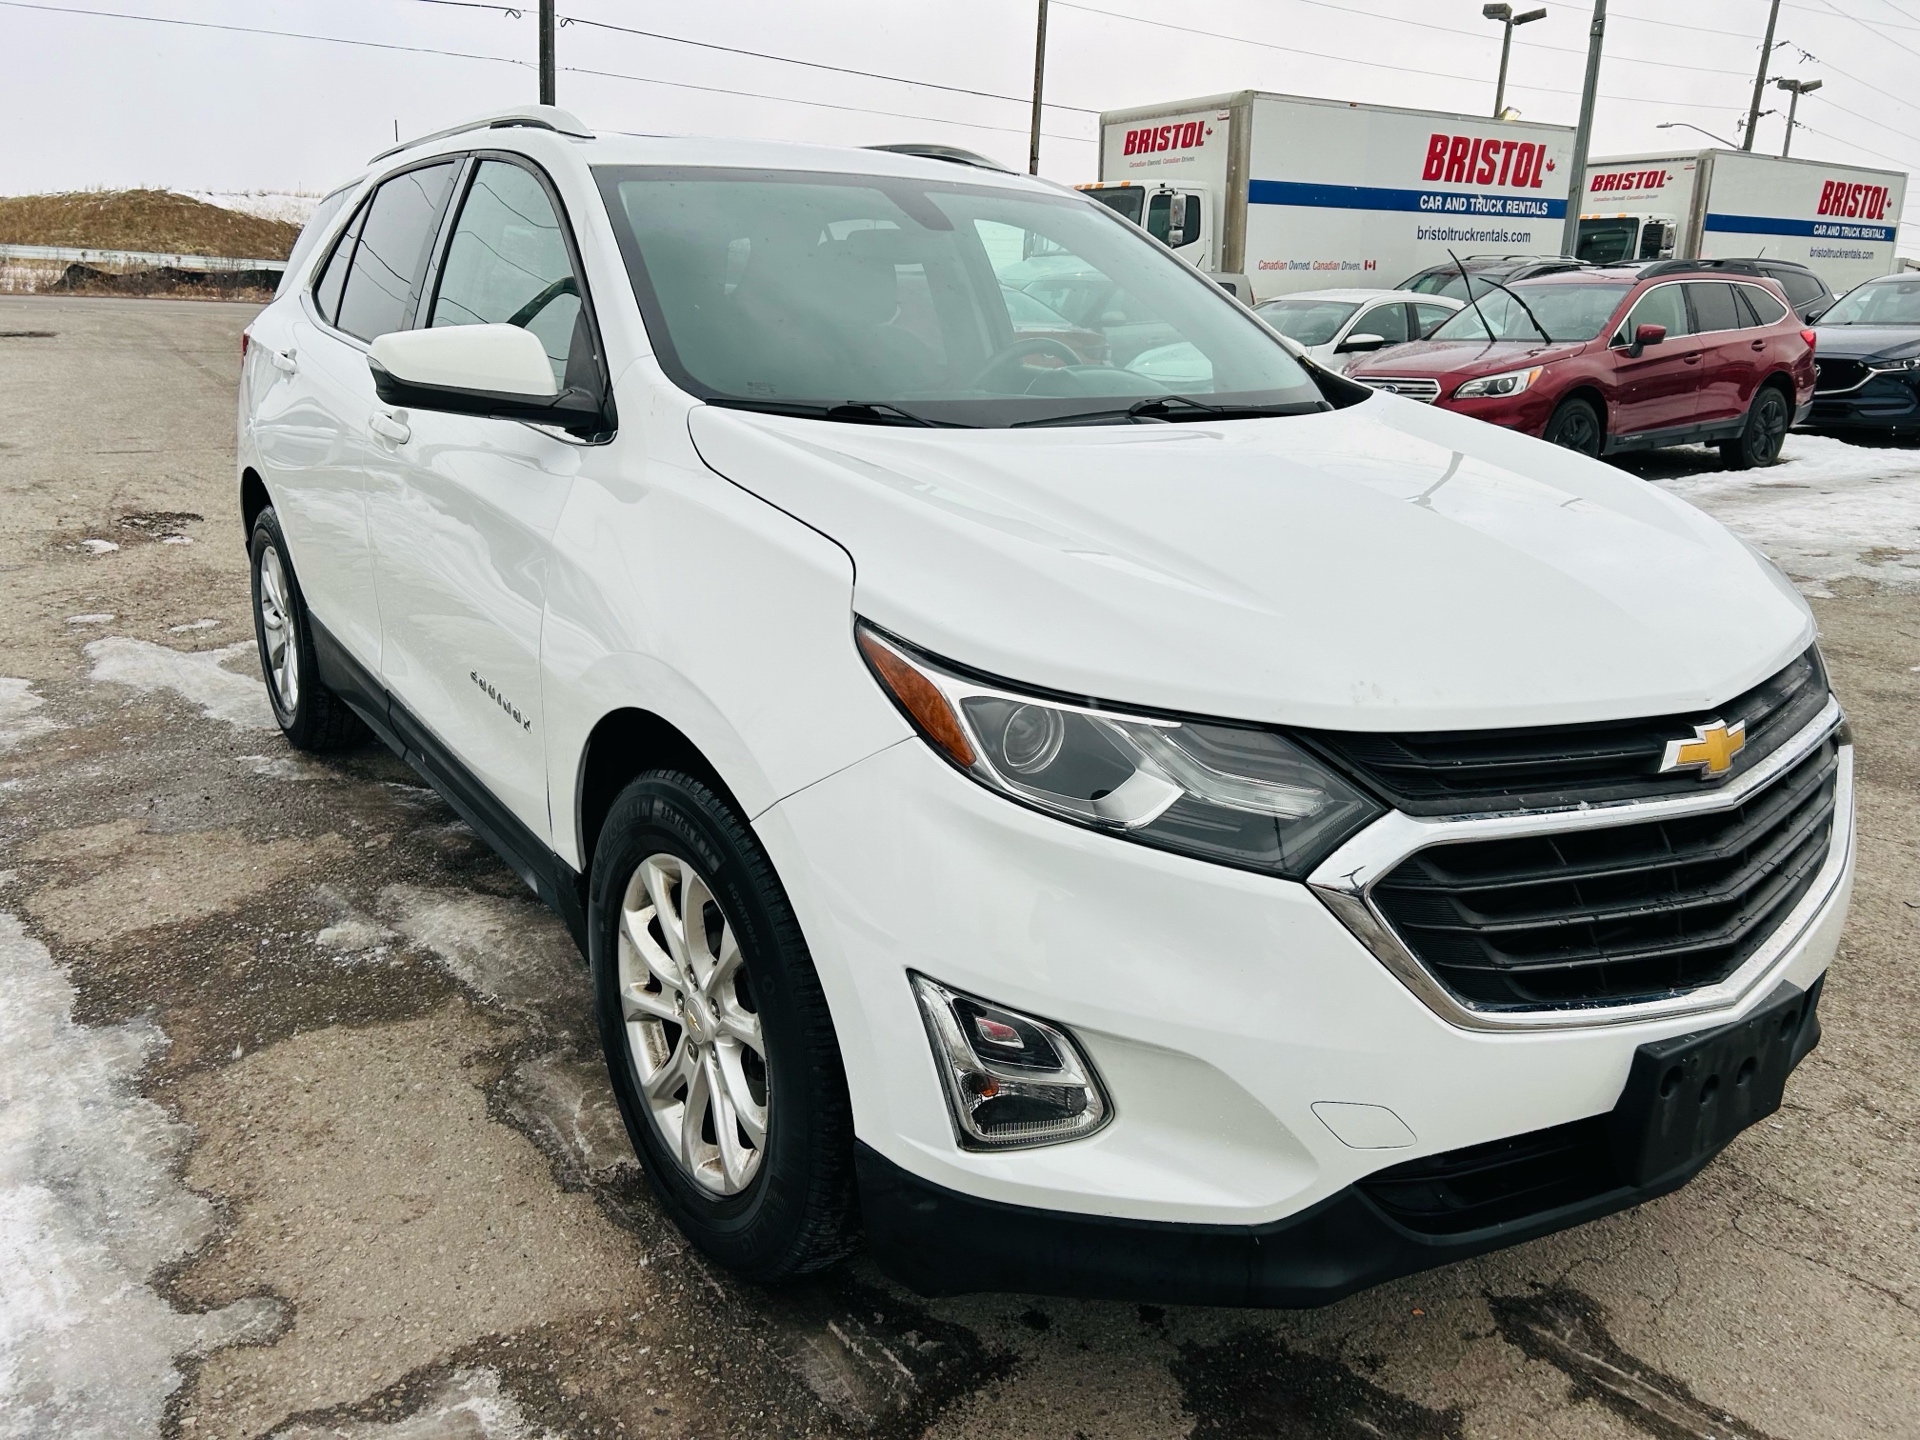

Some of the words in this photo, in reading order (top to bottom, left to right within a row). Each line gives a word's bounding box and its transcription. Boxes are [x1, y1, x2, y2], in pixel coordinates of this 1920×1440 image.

[1124, 121, 1205, 156] BRISTOL
[1163, 157, 1181, 165] Canadian
[1422, 133, 1547, 188] BRISTOL
[1590, 170, 1667, 192] BRISTOL
[1420, 195, 1443, 210] CAR
[1445, 197, 1467, 211] AND
[1470, 198, 1504, 213] TRUCK
[1506, 200, 1548, 215] RENTALS
[1817, 180, 1889, 220] BRISTOL
[1417, 226, 1531, 243] bristoltruckrentals.com
[1813, 224, 1827, 236] CAR
[1827, 225, 1840, 236] AND
[1841, 226, 1861, 238] TRUCK
[1861, 228, 1886, 239] RENTALS
[1809, 246, 1874, 260] bristoltruckrentals.com
[1258, 260, 1287, 271] Canadian
[1288, 260, 1310, 271] Owned.
[1312, 260, 1340, 271] Canadian
[1341, 260, 1361, 271] Driven.
[660, 806, 691, 837] 225/65
[727, 881, 759, 945] ROTATION
